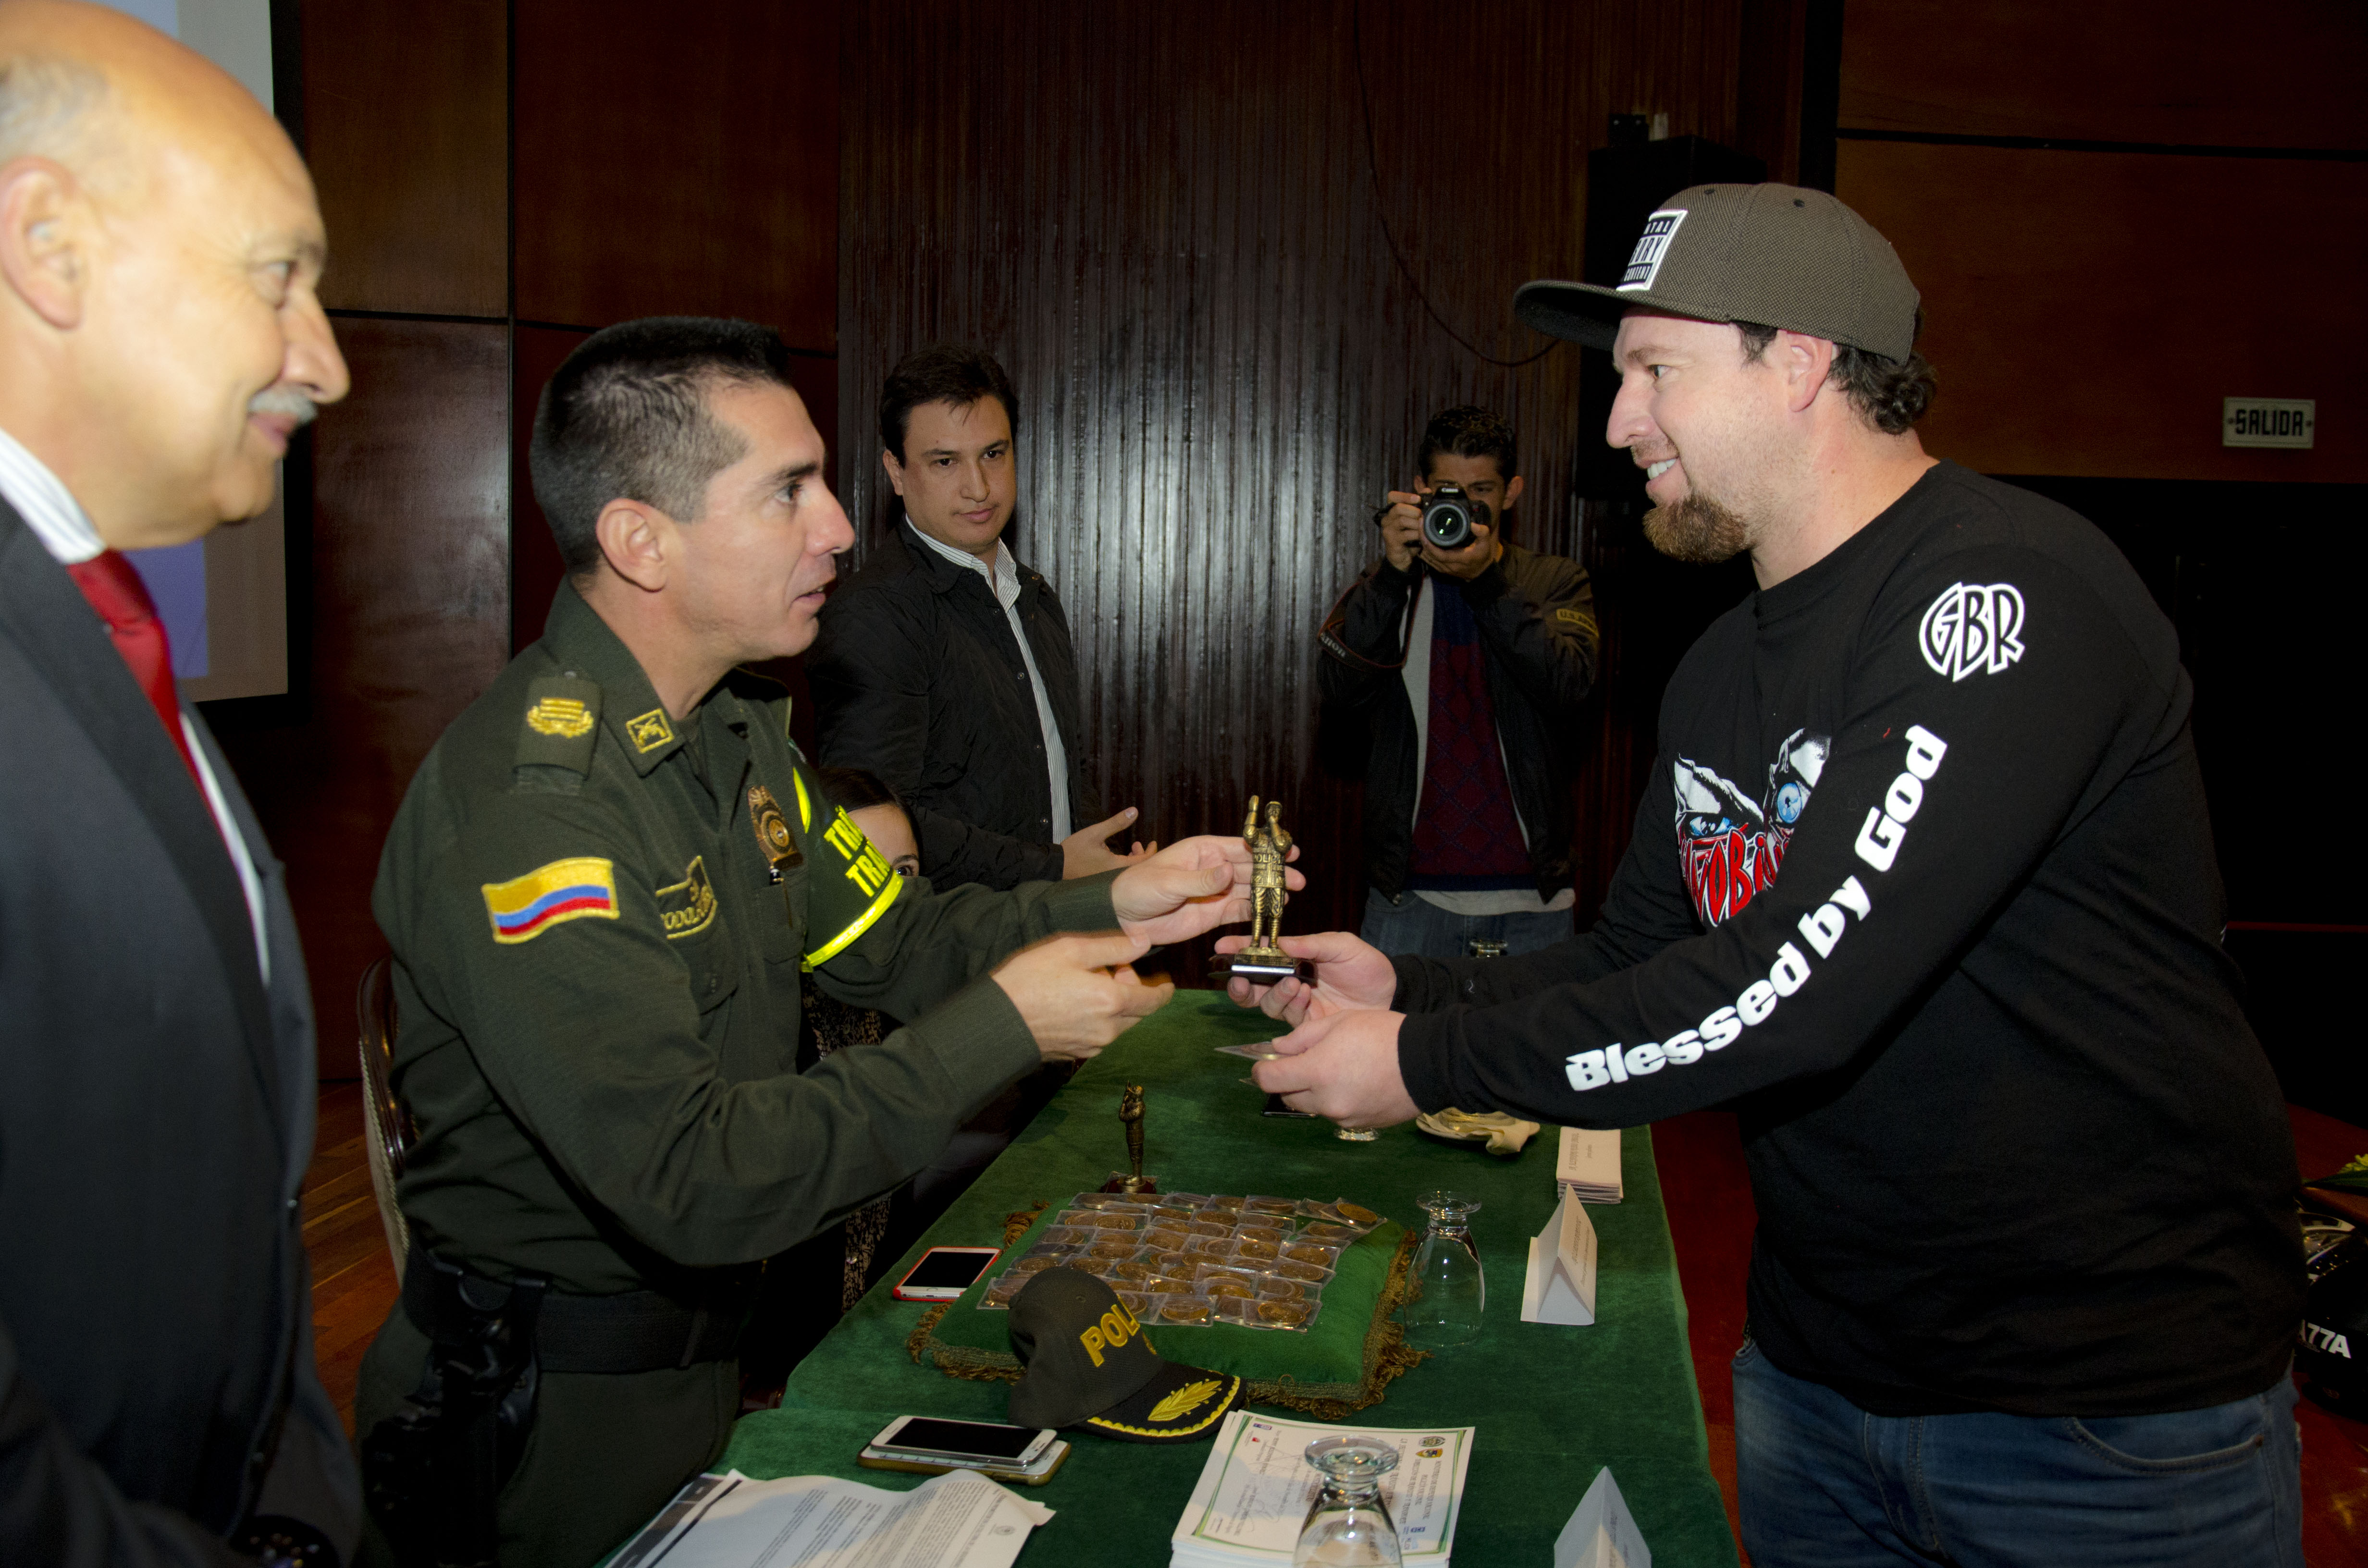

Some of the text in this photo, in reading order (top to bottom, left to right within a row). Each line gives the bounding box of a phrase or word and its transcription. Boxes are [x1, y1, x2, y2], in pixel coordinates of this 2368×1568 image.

[2235, 409, 2304, 436] SALIDA
[1919, 582, 2025, 683] GBR
[845, 837, 890, 898] TRA
[1566, 725, 1948, 1090] Blessed by God
[1080, 1293, 1140, 1368] POL
